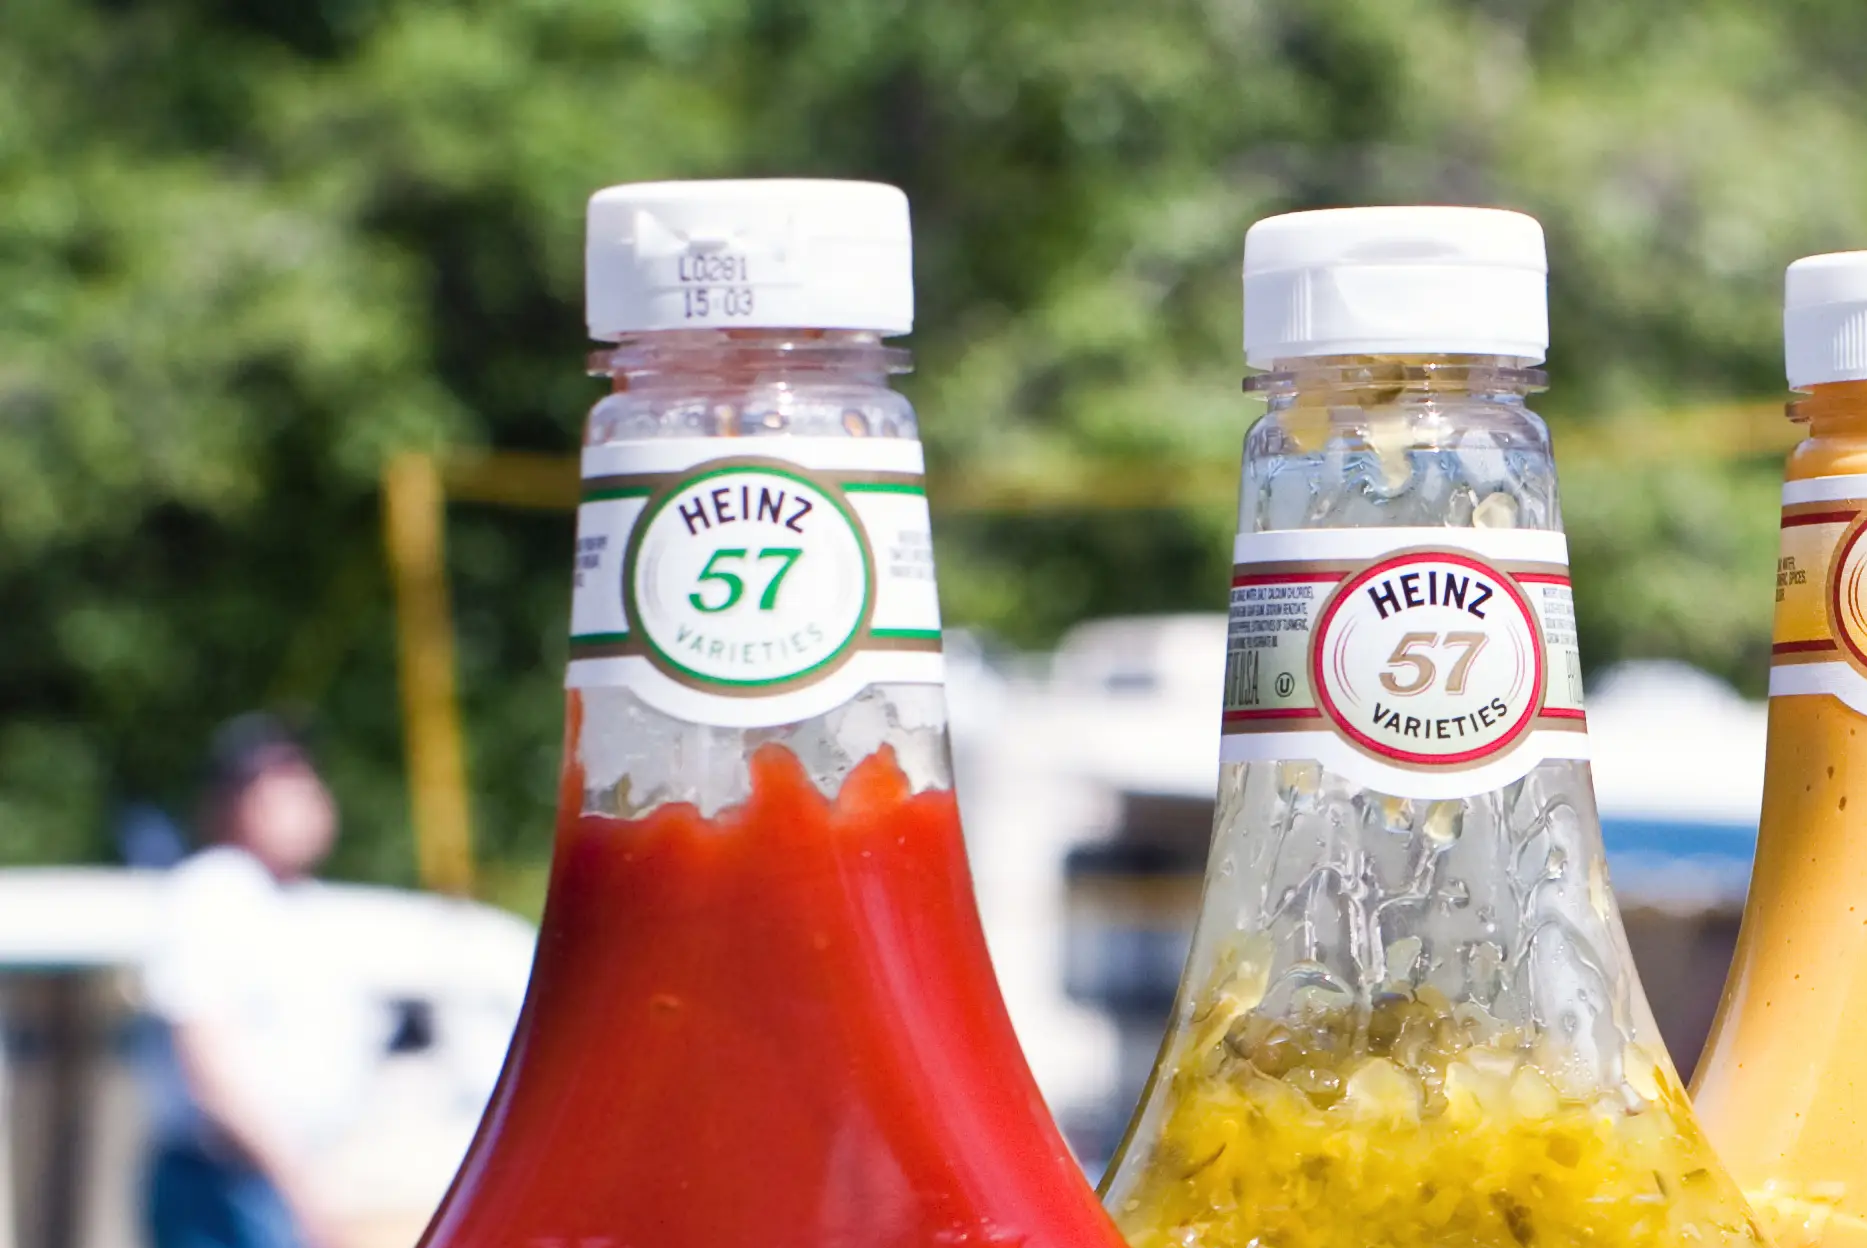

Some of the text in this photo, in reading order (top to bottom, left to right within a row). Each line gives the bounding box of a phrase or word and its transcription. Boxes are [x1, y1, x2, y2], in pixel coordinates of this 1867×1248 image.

[679, 485, 813, 535] HEINZ
[688, 548, 806, 614] 57
[1367, 571, 1493, 619] HEINZ
[676, 623, 825, 666] VARIETIES
[1378, 631, 1490, 697] 57
[1372, 697, 1508, 739] VARIETIES
